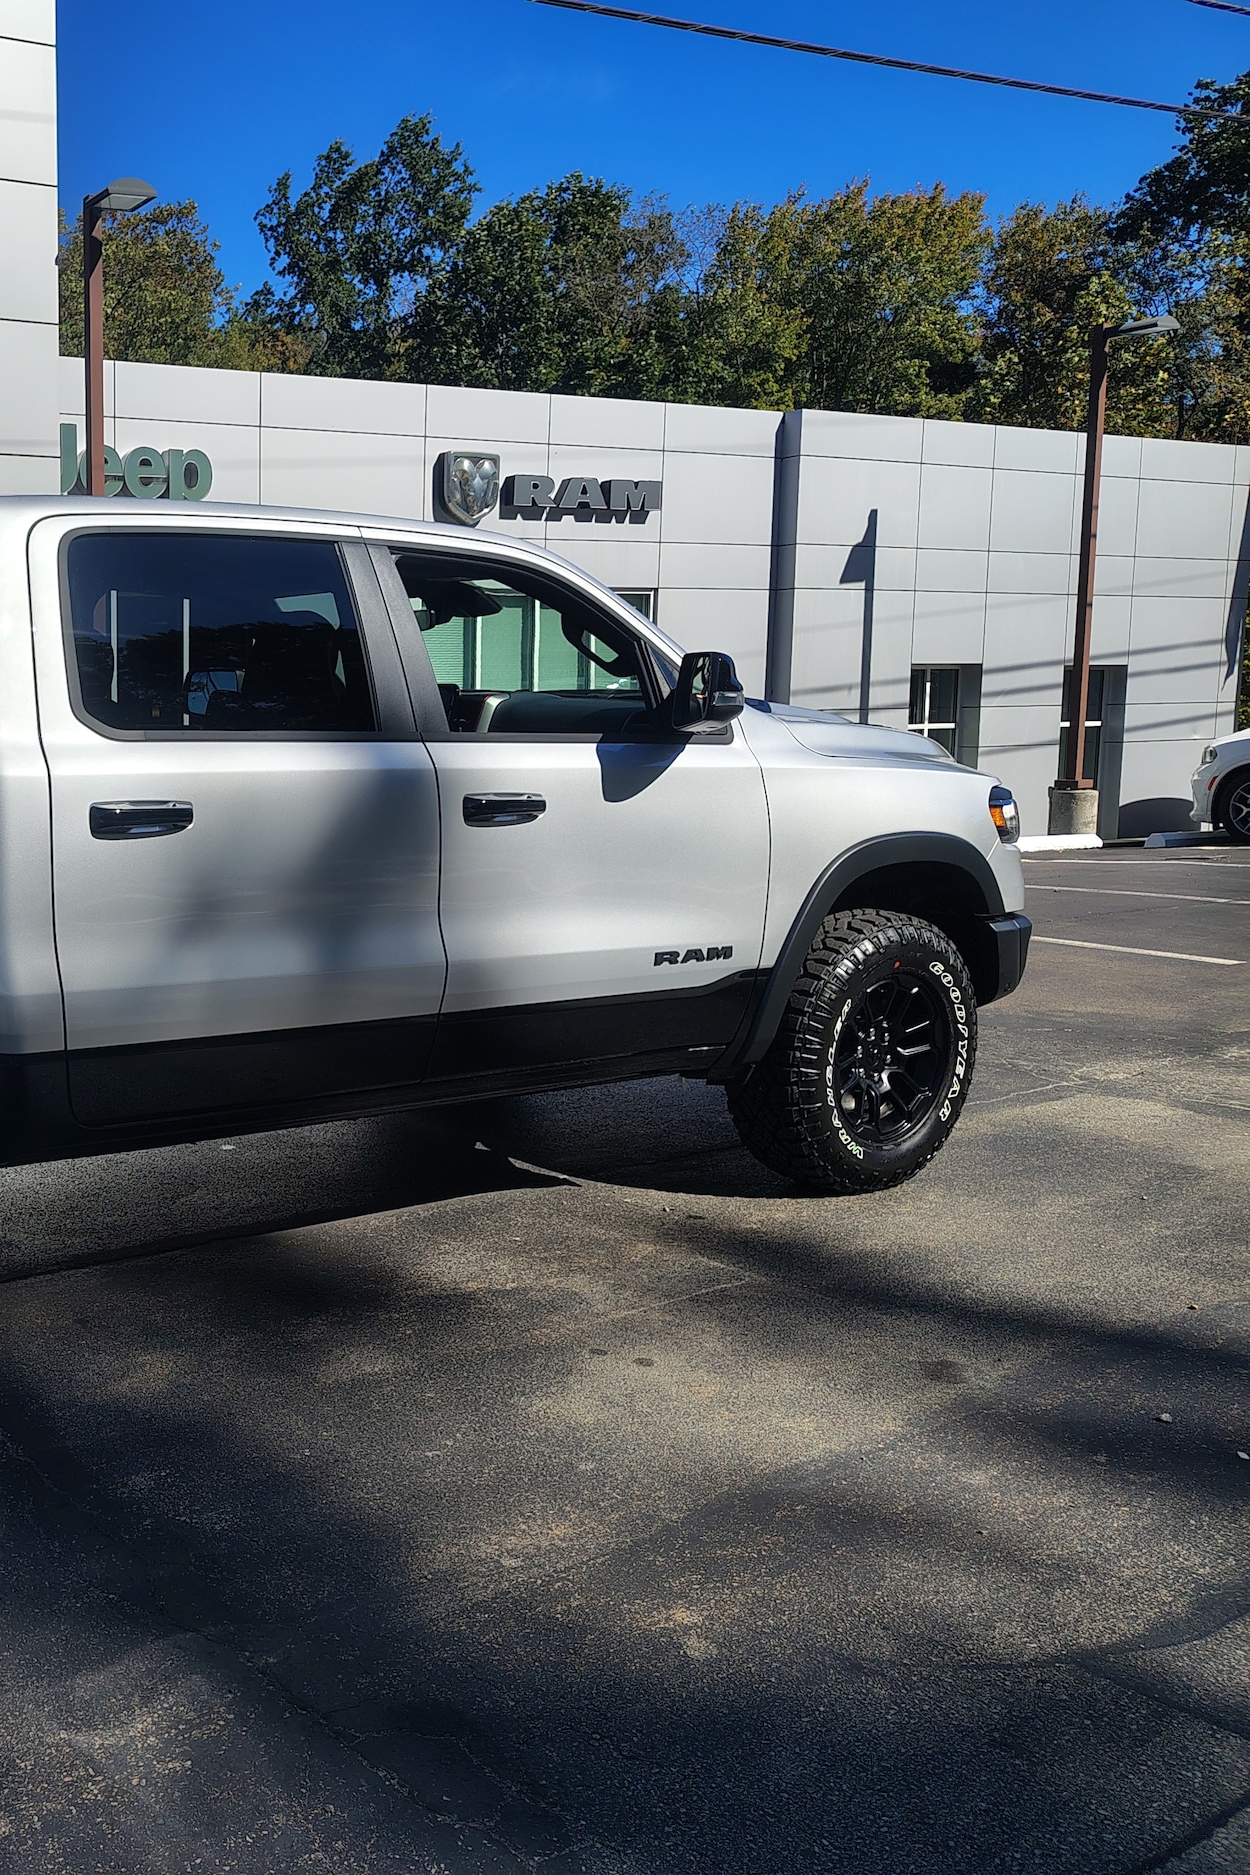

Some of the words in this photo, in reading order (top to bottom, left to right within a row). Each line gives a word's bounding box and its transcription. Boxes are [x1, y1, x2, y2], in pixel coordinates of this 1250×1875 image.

[513, 475, 662, 511] RAM
[654, 946, 733, 967] RAM
[929, 961, 969, 1122] GOODYEAR
